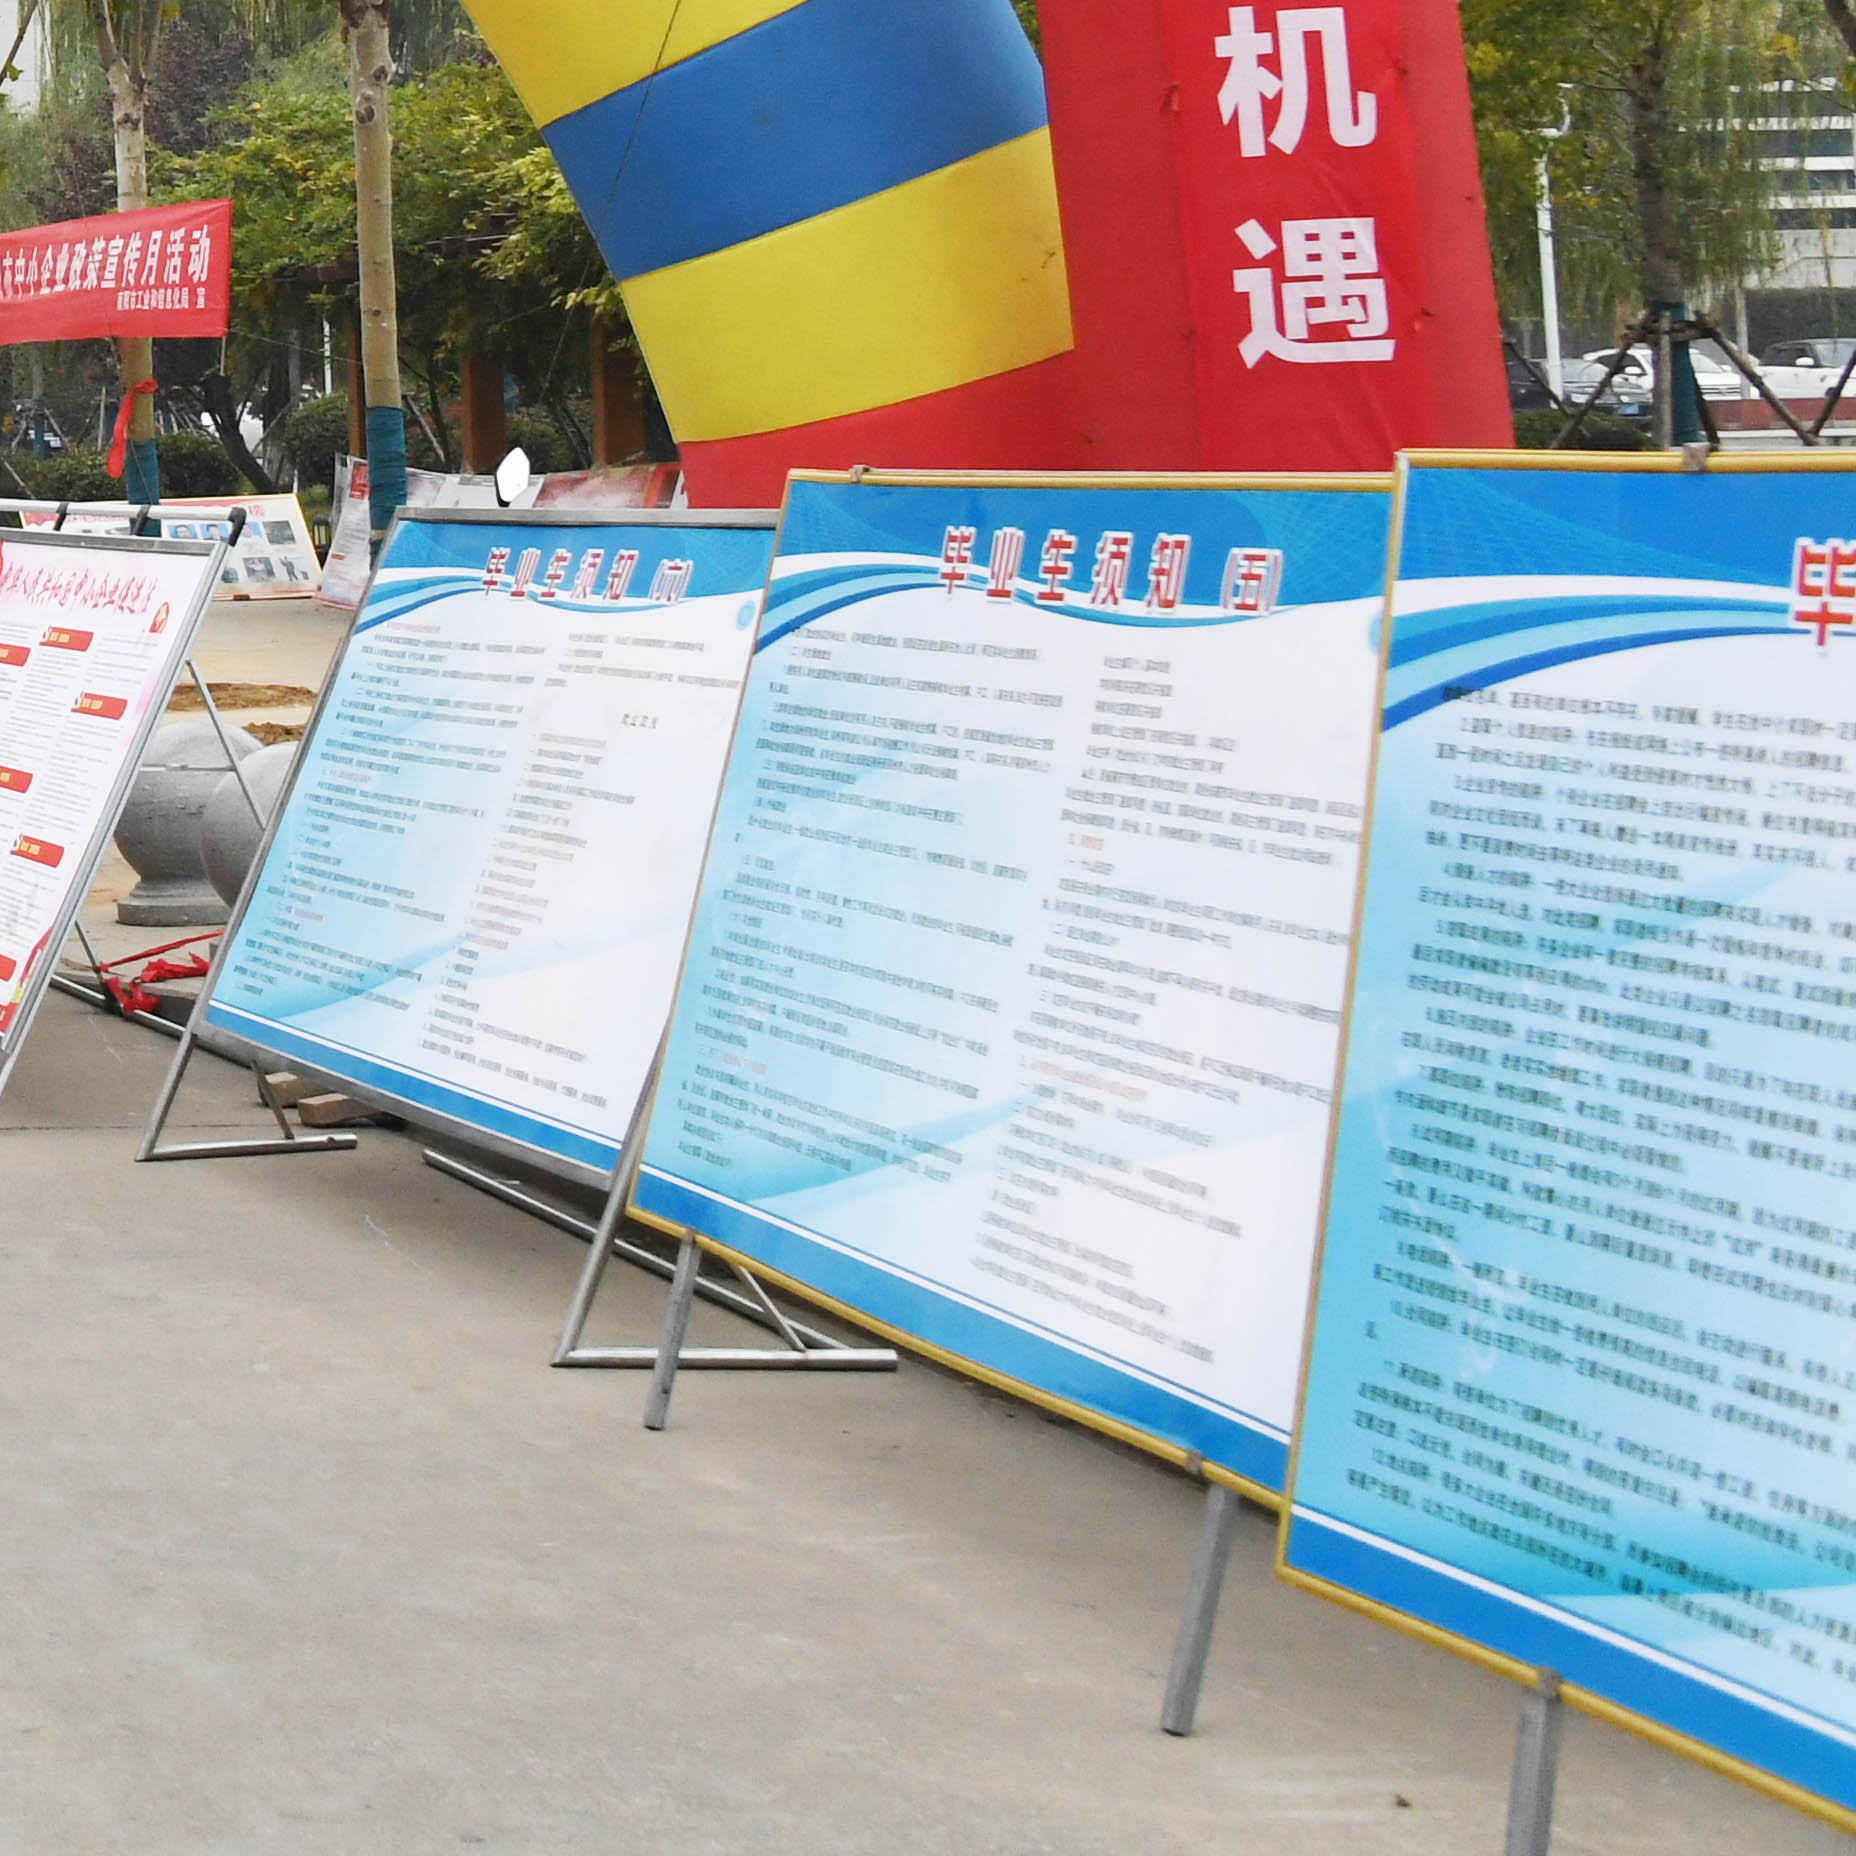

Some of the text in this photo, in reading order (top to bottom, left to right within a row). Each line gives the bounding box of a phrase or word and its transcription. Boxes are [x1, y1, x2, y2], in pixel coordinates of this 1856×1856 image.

[939, 526, 1193, 615] 毕业生须知
